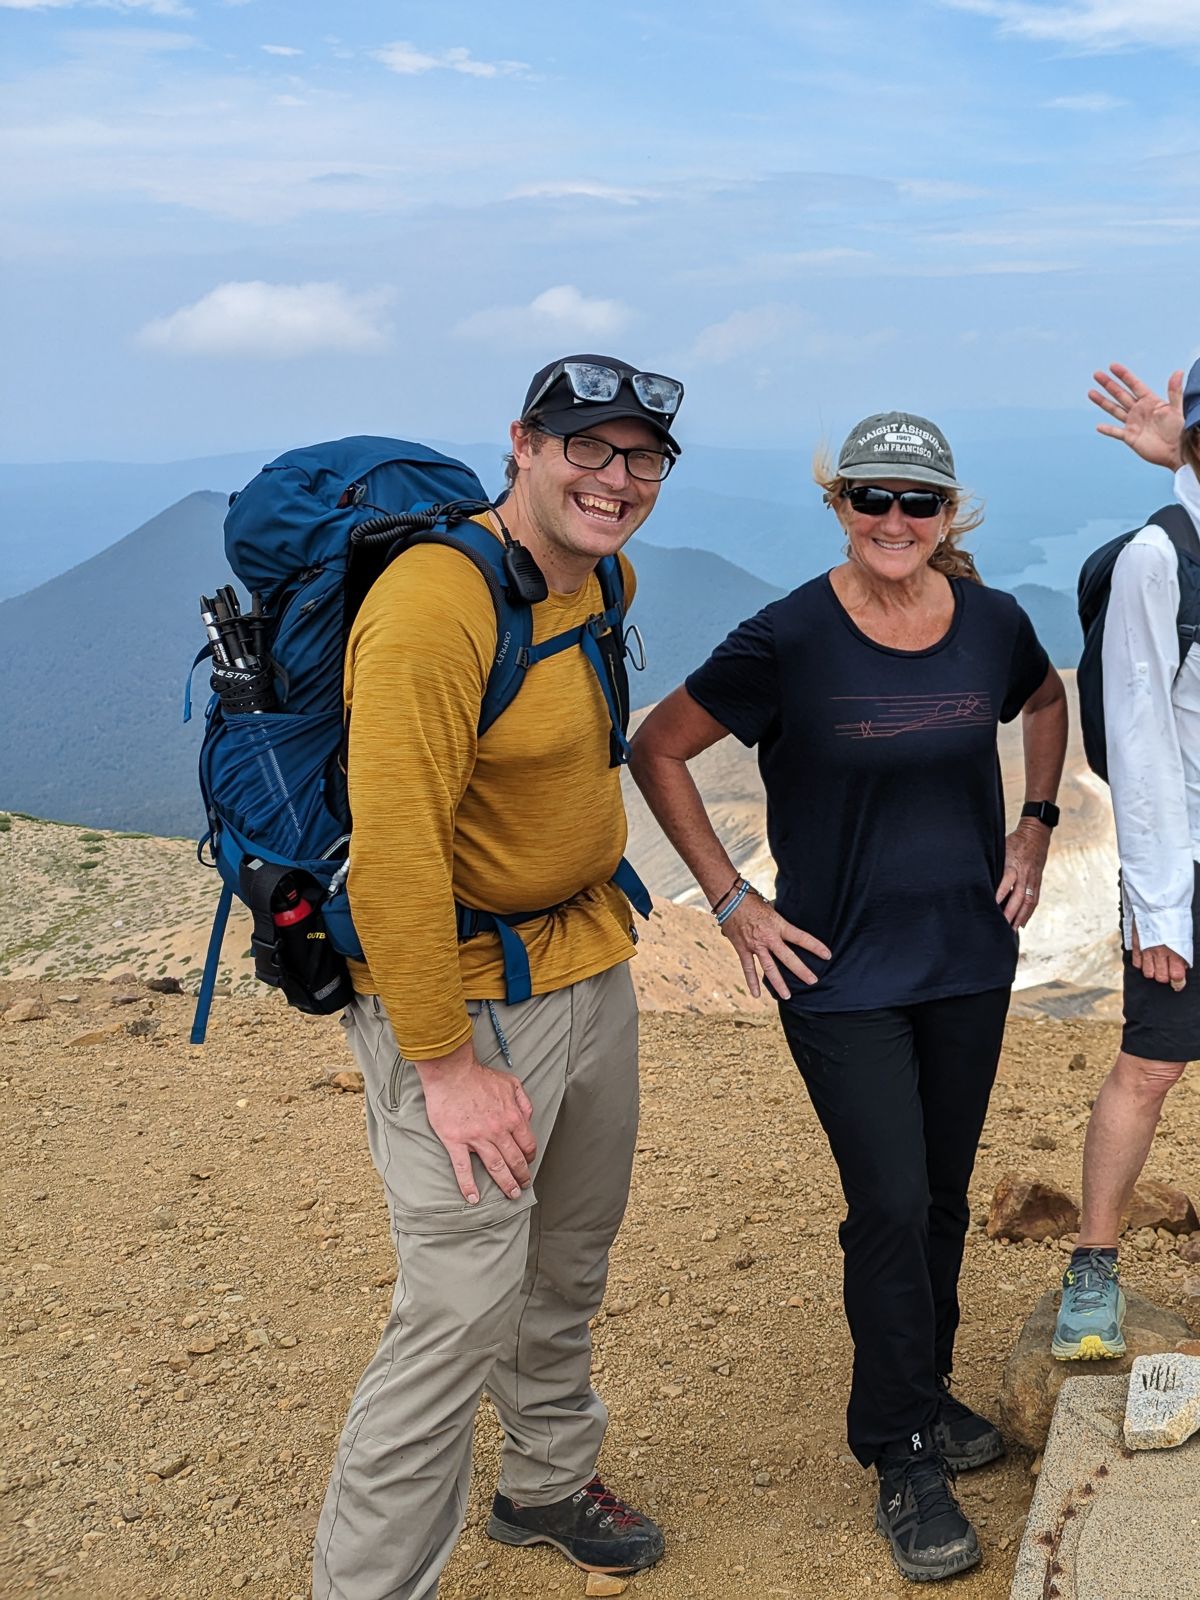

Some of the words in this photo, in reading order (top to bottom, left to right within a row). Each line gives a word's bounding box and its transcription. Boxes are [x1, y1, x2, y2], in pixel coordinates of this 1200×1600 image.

[857, 423, 899, 446] HAIGHT
[899, 423, 945, 454] ASHBURY
[873, 443, 890, 453] SAN
[890, 443, 932, 459] FRANCISCO
[496, 631, 511, 666] OSPREY
